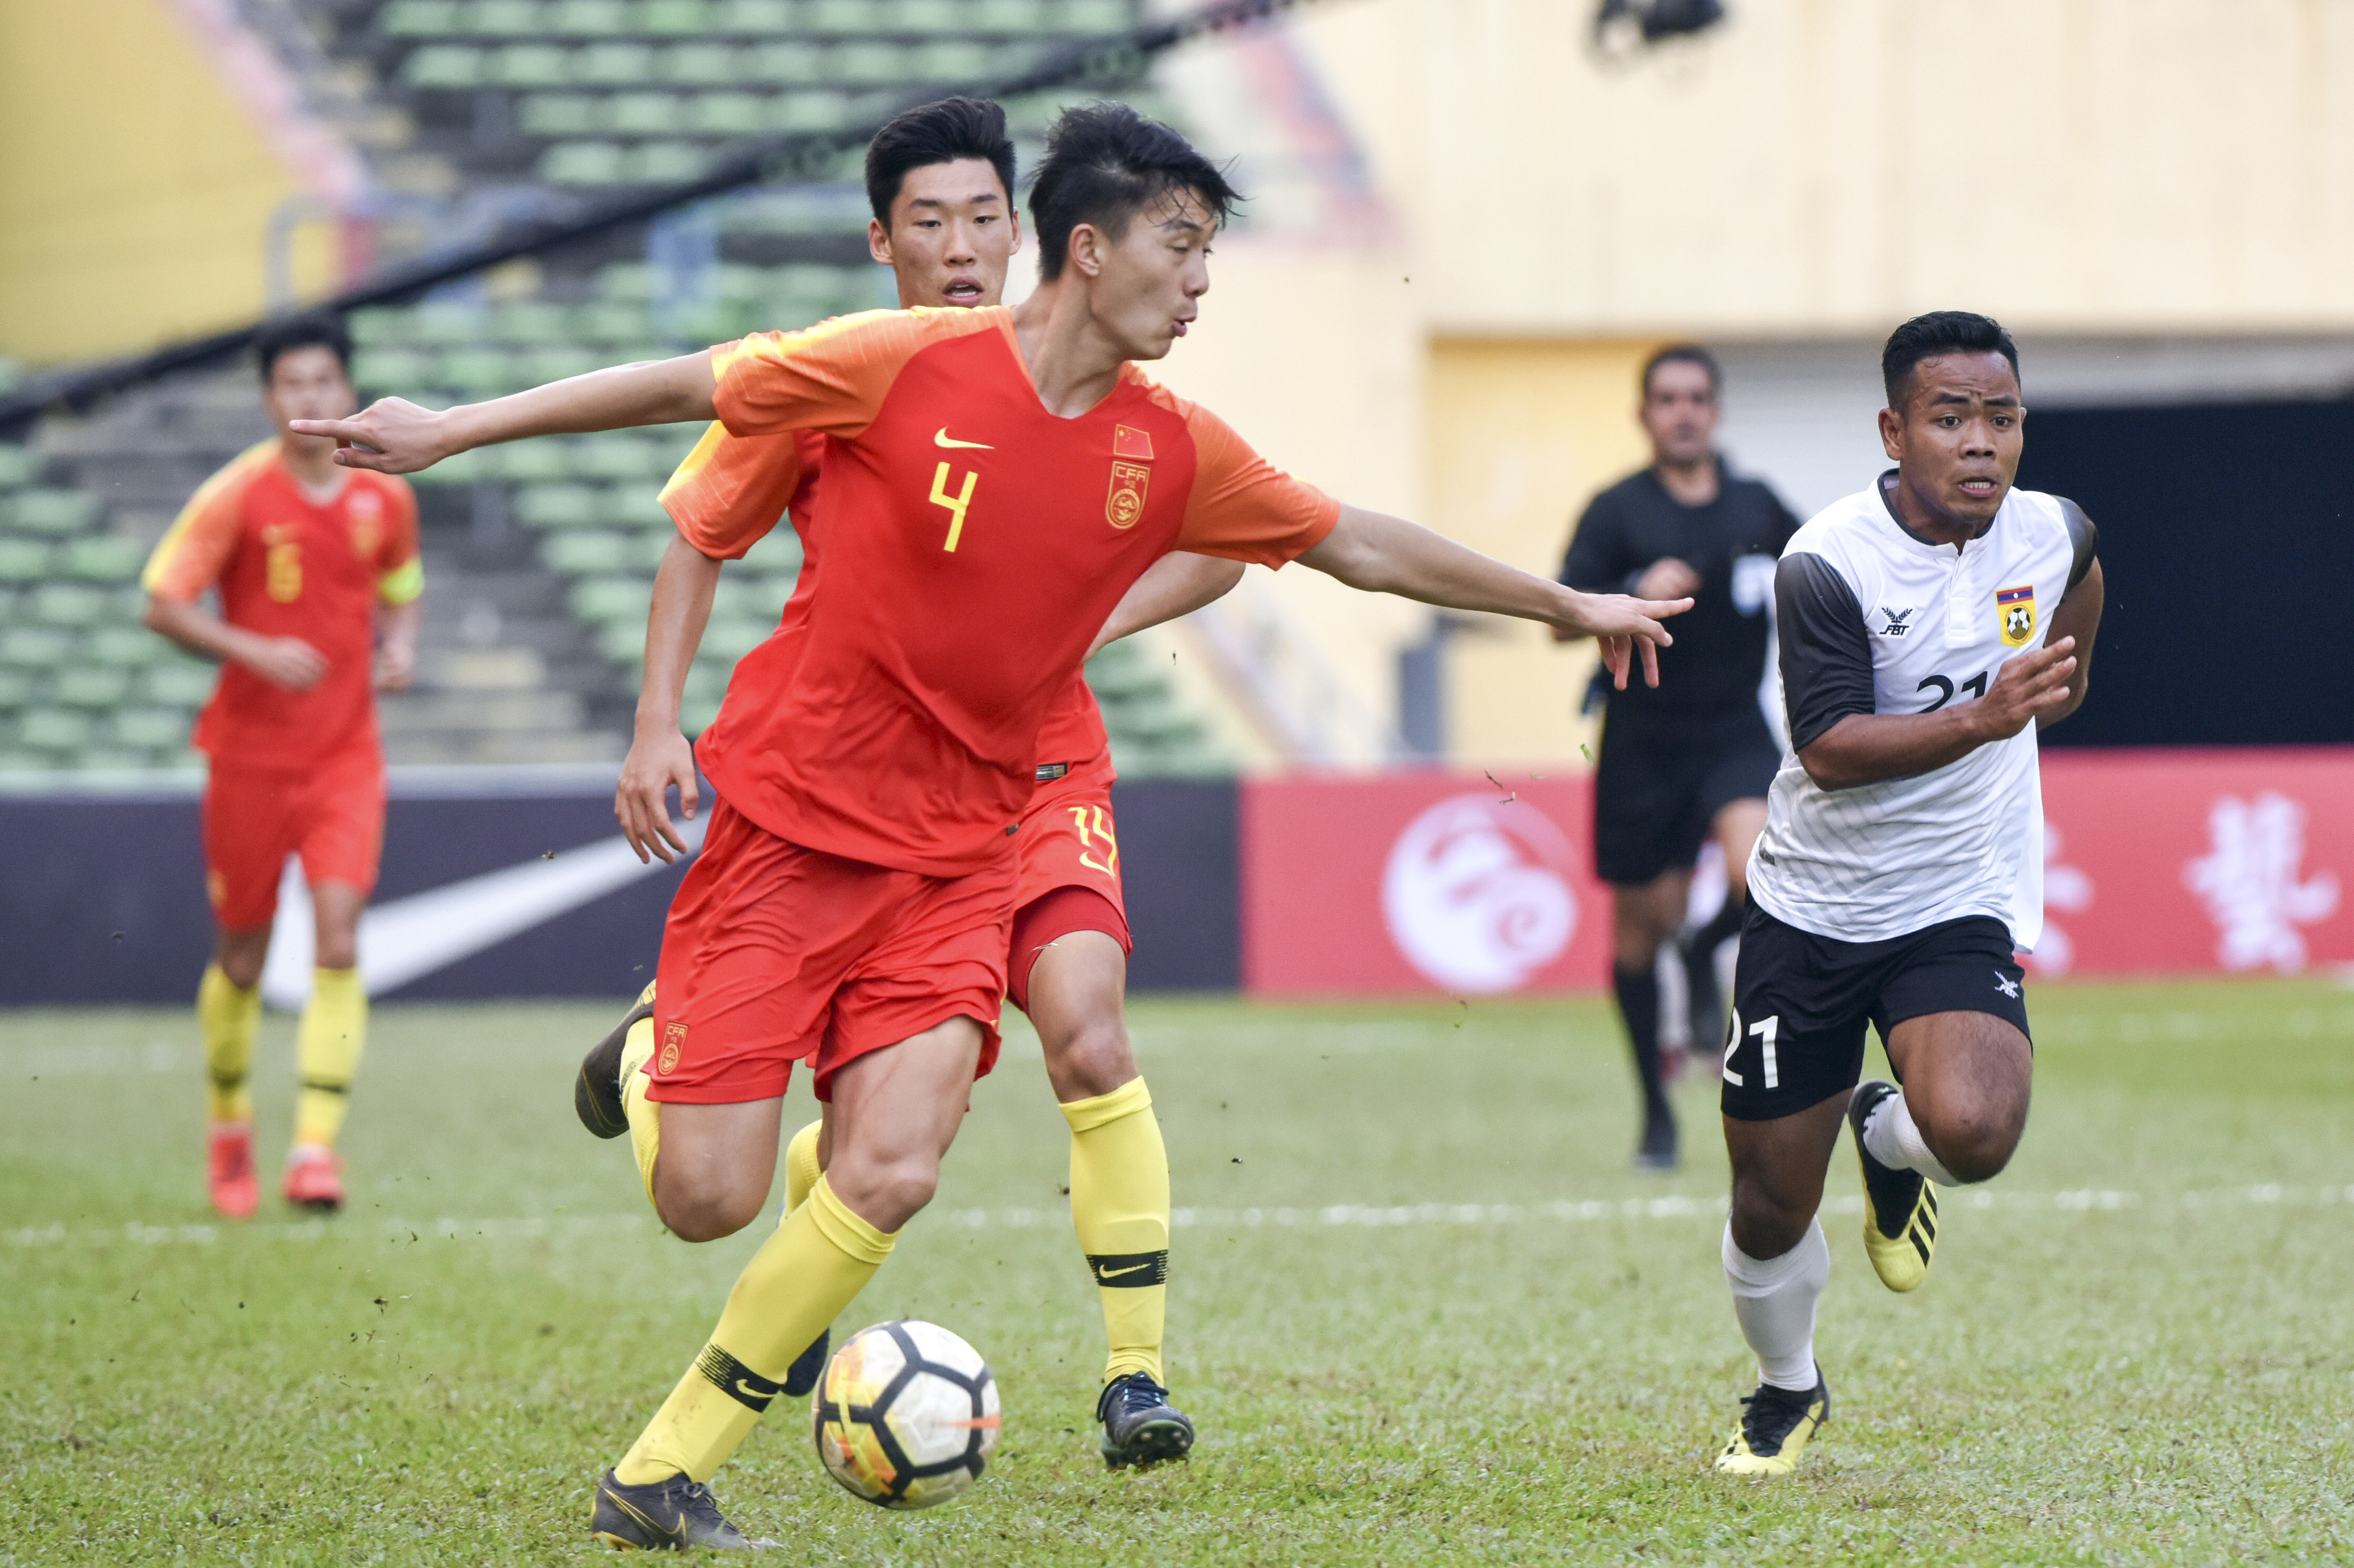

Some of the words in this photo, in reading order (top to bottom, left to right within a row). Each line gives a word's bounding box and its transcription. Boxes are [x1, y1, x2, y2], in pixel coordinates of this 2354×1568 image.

[1116, 466, 1148, 482] CFA
[930, 461, 978, 552] 4
[1879, 624, 1910, 636] FBT
[1068, 805, 1118, 877] 14
[667, 1025, 686, 1038] CFA
[1723, 1006, 1779, 1089] 21
